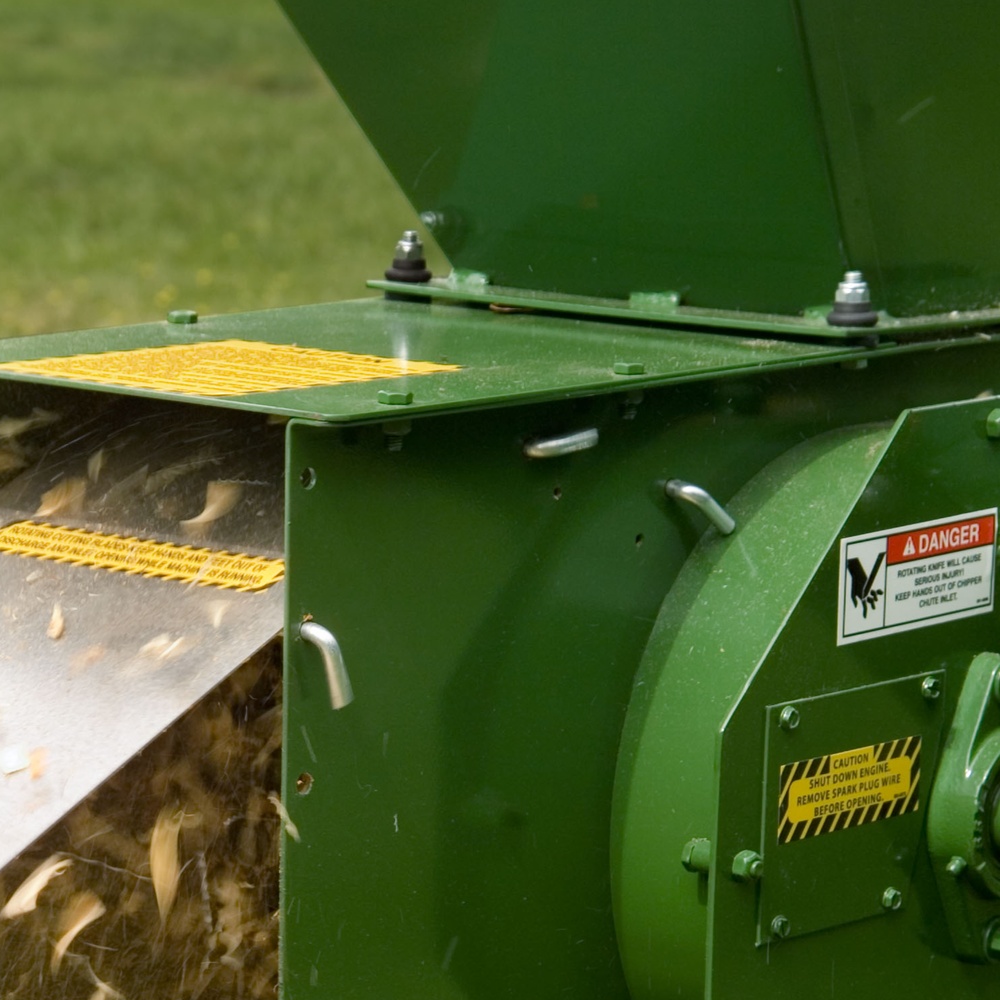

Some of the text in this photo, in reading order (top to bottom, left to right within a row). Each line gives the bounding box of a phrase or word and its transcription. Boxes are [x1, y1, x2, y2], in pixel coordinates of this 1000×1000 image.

[9, 525, 51, 541] ROTATING
[52, 531, 92, 545] CUTTING
[919, 523, 980, 554] DANGER
[897, 553, 982, 578] ROTATING KNIFE WILL CAUSE
[914, 568, 965, 586] SERIOUS INJURY!
[895, 576, 982, 602] KEEP HANDS OUT OF CHIPPER
[919, 592, 958, 608] CHUTE INLET.
[833, 753, 869, 769] CAUTION
[809, 763, 891, 789] SHUT DOWN ENGINE.
[797, 773, 901, 807] REMOVE SPARK PLUG WIRE
[814, 801, 844, 817] BEFORE
[846, 792, 884, 810] OPENING.
